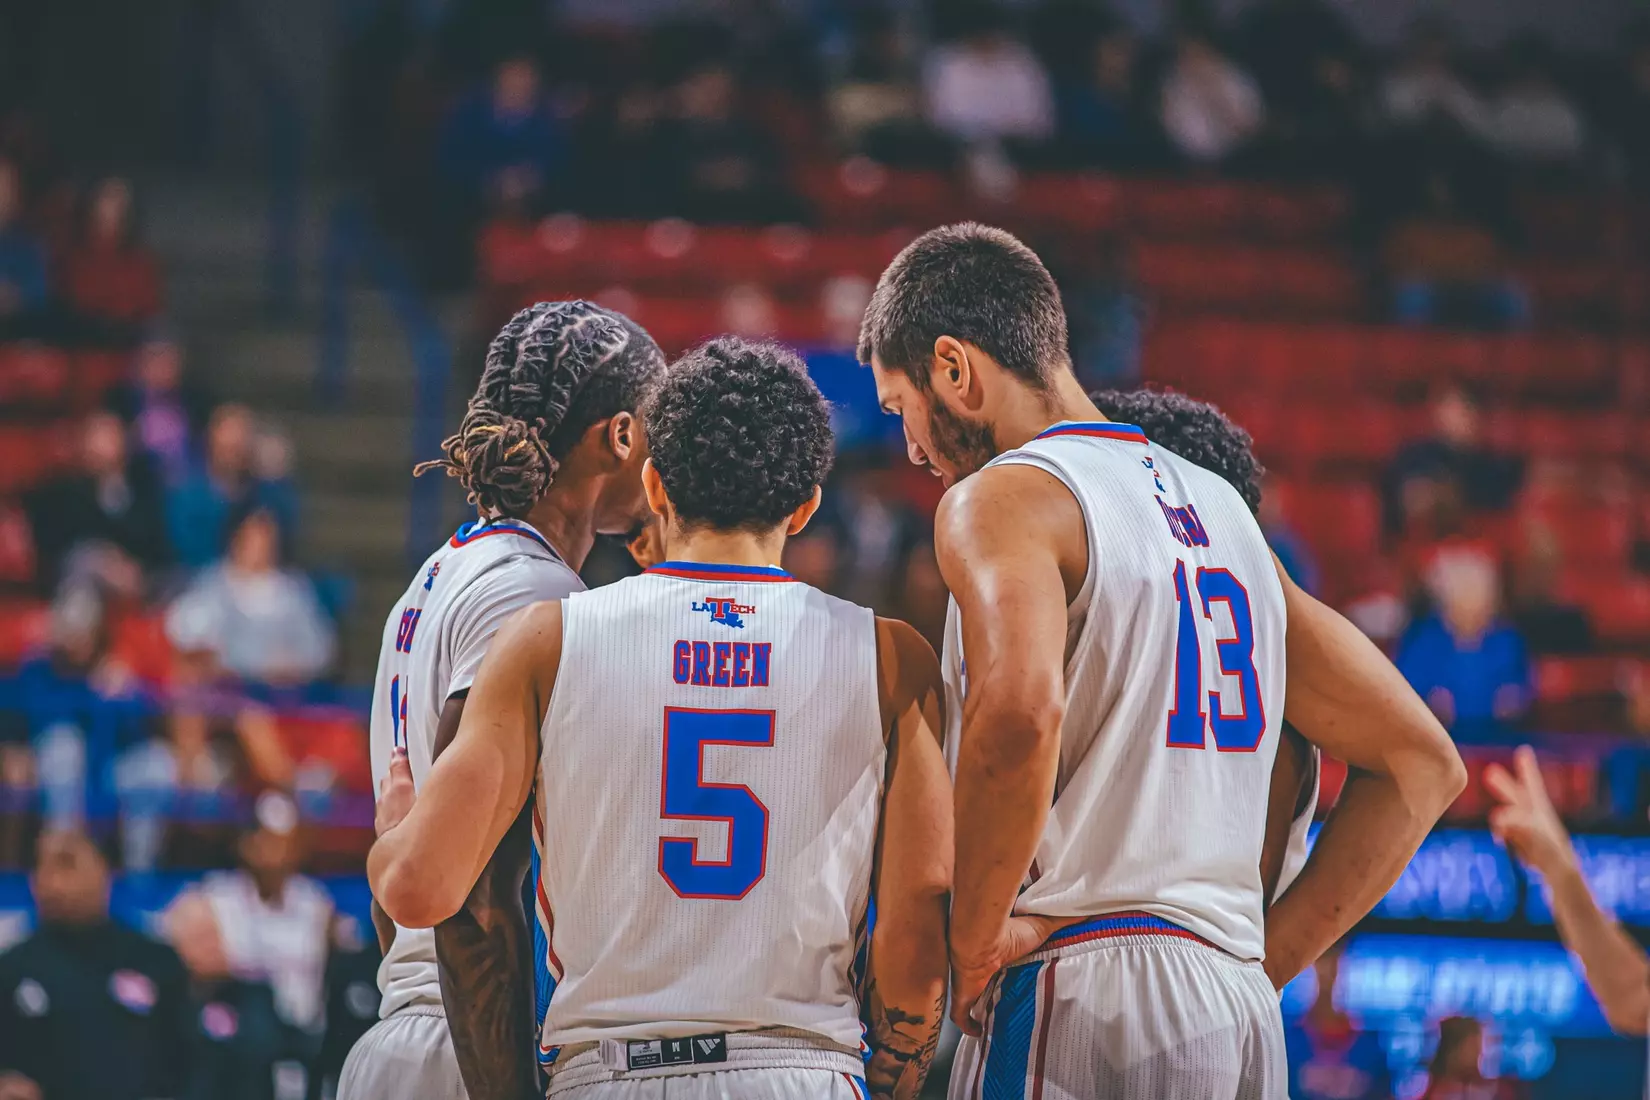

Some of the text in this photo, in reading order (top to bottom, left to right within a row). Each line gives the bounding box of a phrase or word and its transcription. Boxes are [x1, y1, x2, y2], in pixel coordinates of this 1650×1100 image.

[672, 639, 772, 688] GREEN
[1166, 558, 1267, 752] 13
[658, 706, 776, 901] 5
